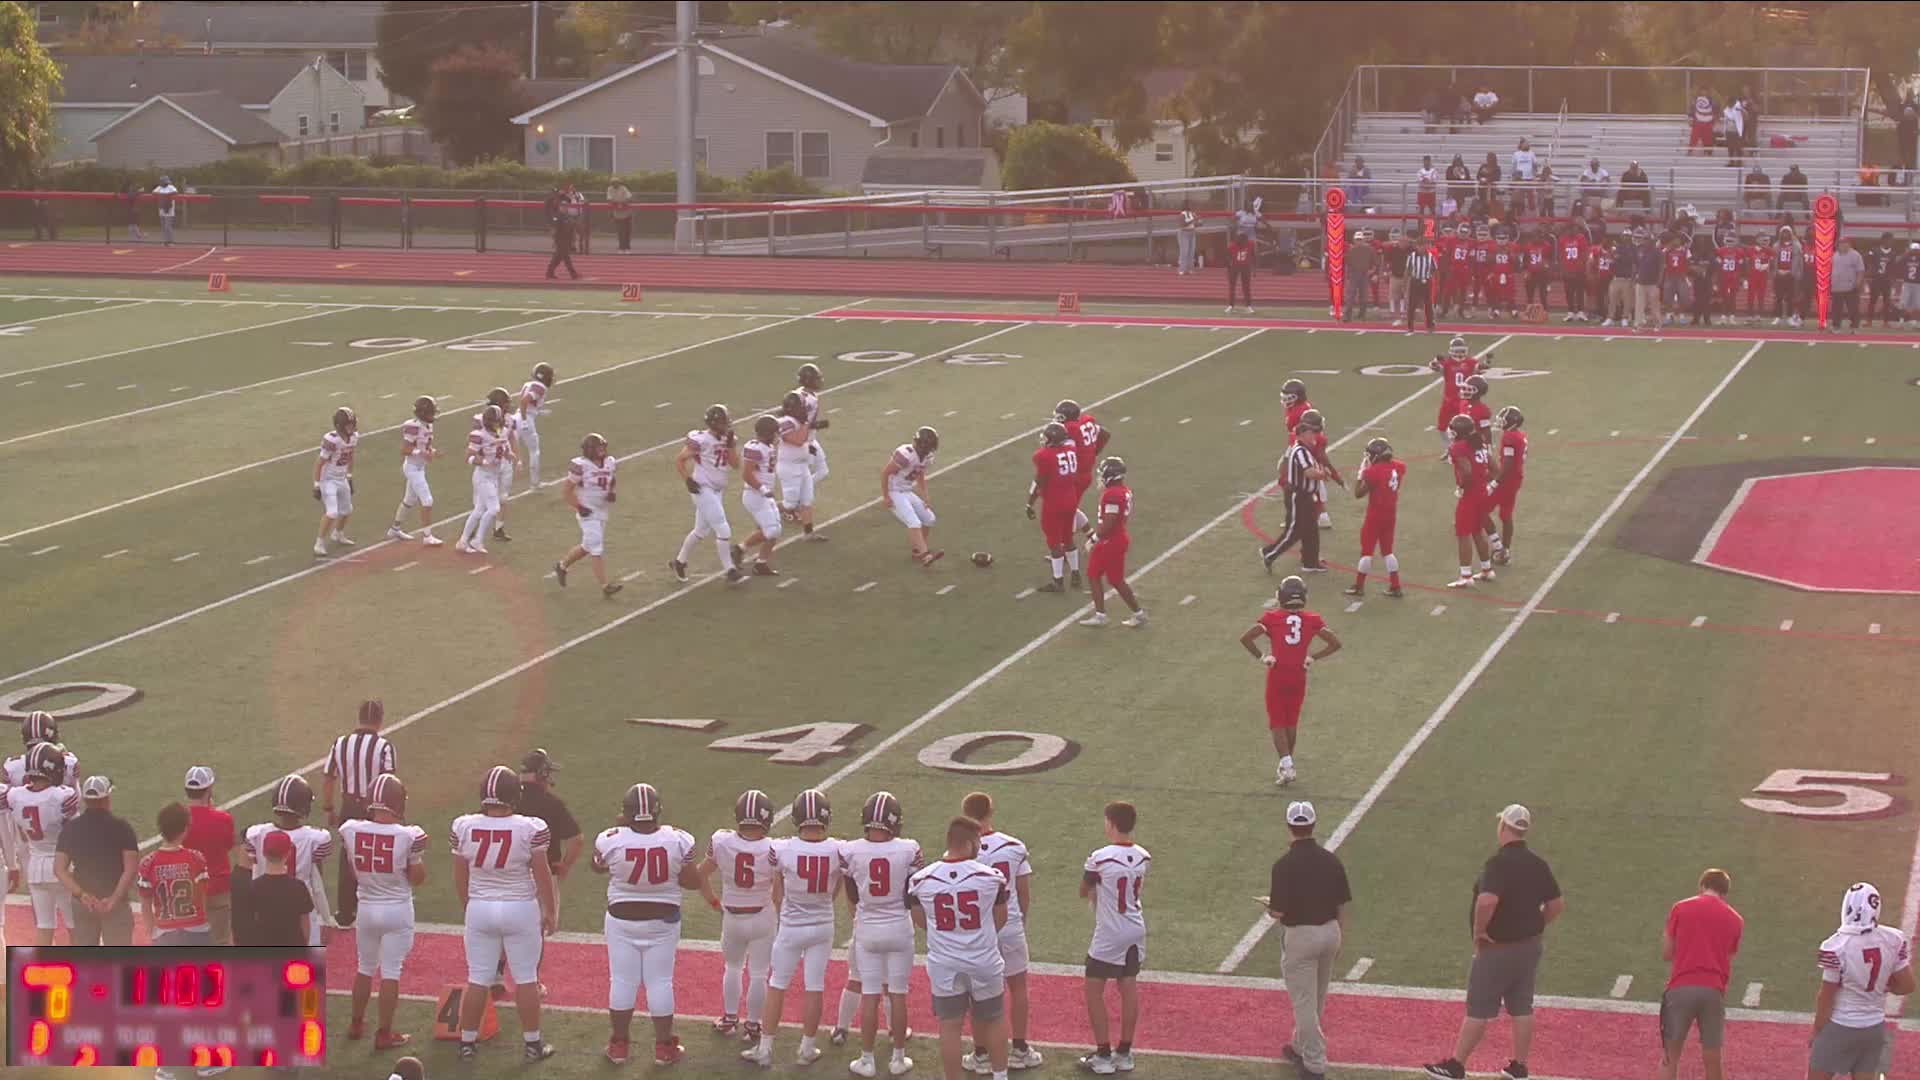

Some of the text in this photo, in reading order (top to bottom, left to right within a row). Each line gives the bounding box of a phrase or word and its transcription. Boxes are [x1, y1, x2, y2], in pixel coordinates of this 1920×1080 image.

[1056, 450, 1078, 475] 50
[1388, 469, 1399, 491] 4
[1285, 614, 1302, 645] 3
[354, 832, 395, 873] 55
[471, 829, 513, 869] 77
[625, 846, 669, 885] 70
[734, 852, 755, 888] 6
[797, 855, 830, 893] 41
[869, 857, 890, 896] 9
[157, 879, 198, 919] 12
[934, 890, 980, 931] 65
[1862, 947, 1882, 992] 7
